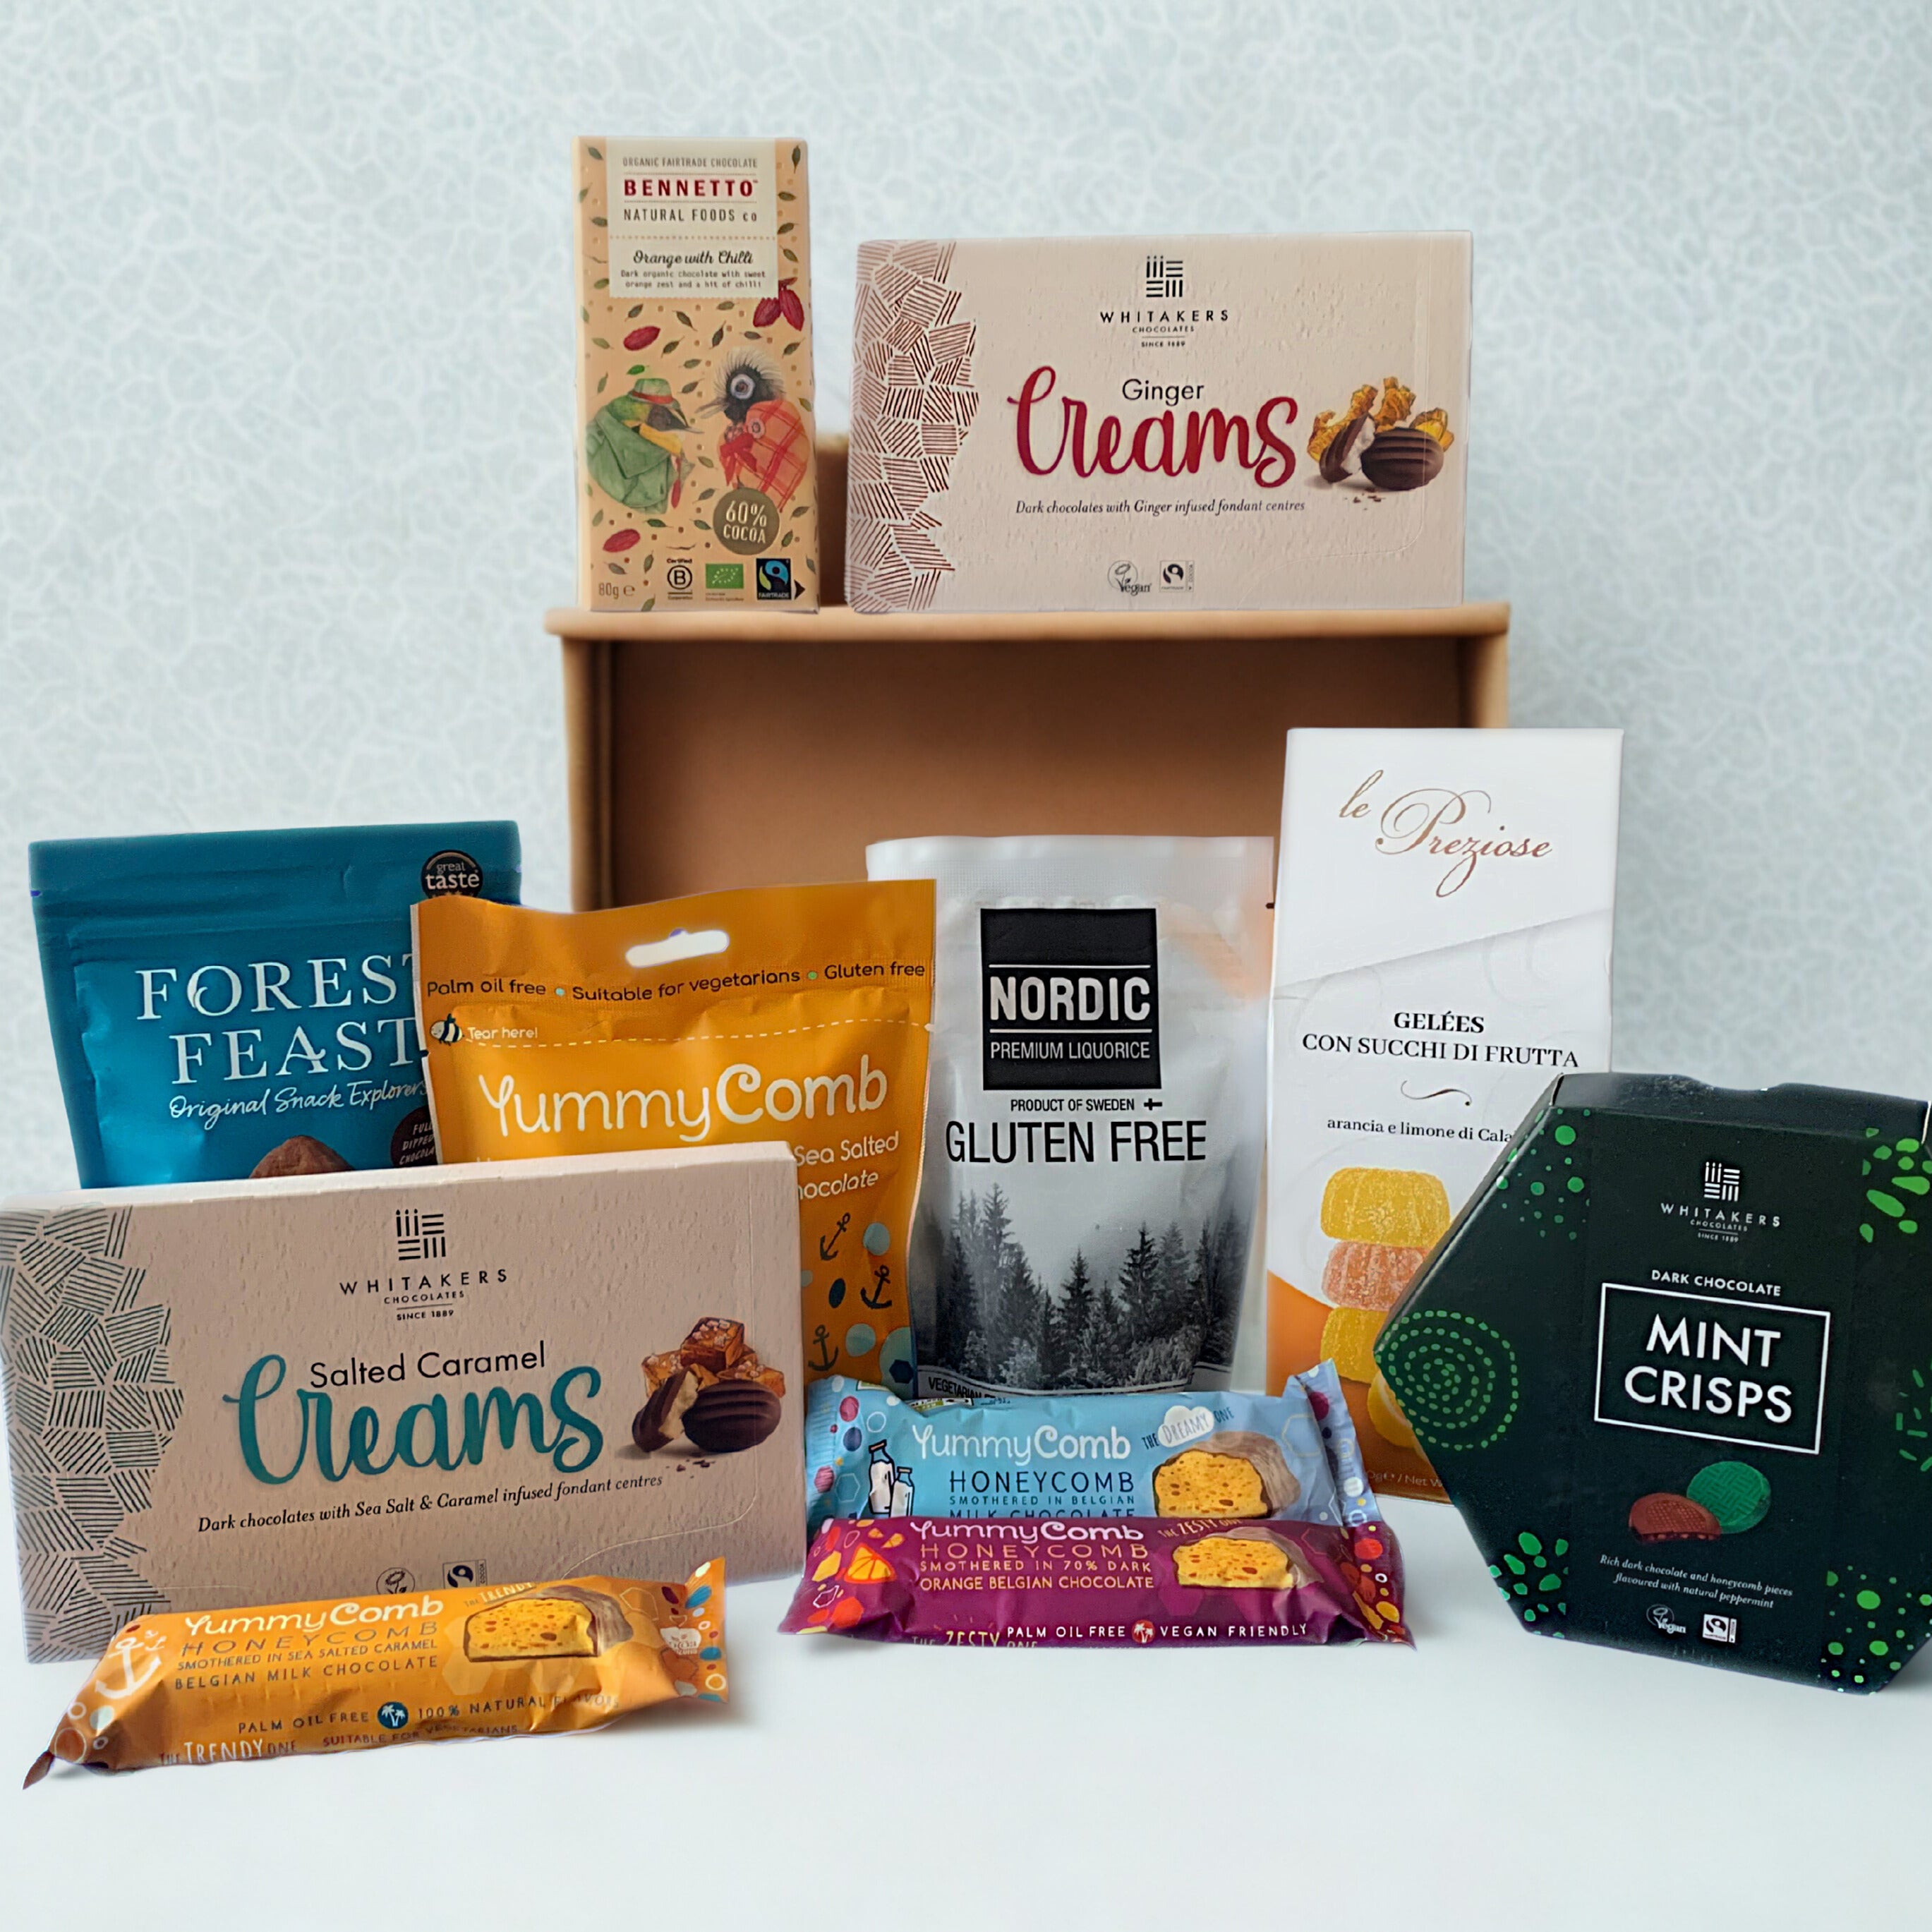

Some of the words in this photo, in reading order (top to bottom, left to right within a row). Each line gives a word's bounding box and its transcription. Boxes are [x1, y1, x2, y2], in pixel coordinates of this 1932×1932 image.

[623, 157, 659, 168] ORGANIC
[662, 157, 707, 168] FAIRTRADE
[711, 157, 758, 169] CHOCOLATE
[624, 209, 684, 222] NATURAL
[692, 209, 735, 222] FOODS
[633, 249, 682, 268] Orange
[684, 250, 713, 264] with
[718, 249, 754, 265] Chilli
[621, 270, 639, 278] Dark
[643, 270, 674, 279] organic
[678, 270, 718, 278] chocolate
[722, 270, 740, 278] with
[1100, 310, 1229, 323] WHITAKERS
[1122, 378, 1204, 406] Ginger
[1007, 366, 1298, 488] Creams
[726, 500, 766, 528] 60%
[1016, 500, 1044, 514] Dark
[1046, 500, 1103, 514] chocolates
[1106, 500, 1130, 513] with
[1134, 500, 1172, 516] Ginger
[1175, 500, 1215, 514] infused
[1216, 500, 1262, 516] fondant
[1266, 500, 1305, 512] centres
[723, 524, 766, 544] COCOA
[1339, 770, 1384, 818] le
[1375, 788, 1552, 898] Preziose
[425, 872, 480, 890] taste
[437, 862, 465, 875] great
[427, 979, 474, 997] Palm
[481, 979, 503, 994] oil
[509, 979, 546, 995] free
[572, 986, 653, 1001] Suitable
[658, 982, 685, 998] for
[689, 969, 800, 992] vegetarians
[824, 964, 884, 980] Gluten
[890, 961, 925, 977] free
[989, 976, 1150, 1021] NORDIC
[468, 1027, 498, 1040] Tear
[502, 1026, 538, 1039] here!
[1394, 1010, 1484, 1033] GELÉES
[169, 1017, 418, 1085] FEAST
[991, 1042, 1063, 1059] PREMIUM
[1068, 1042, 1150, 1060] LIQUORICE
[1303, 1033, 1353, 1053] CON
[1358, 1037, 1446, 1060] SUCCHI
[1453, 1044, 1478, 1061] DI
[1484, 1045, 1578, 1068] FRUTTA
[169, 1089, 270, 1130] Original
[274, 1087, 344, 1113] Snack
[478, 1054, 887, 1142] YummyComb
[1010, 1099, 1064, 1111] PRODUCT
[1068, 1099, 1082, 1111] OF
[1086, 1099, 1135, 1111] SWEDEN
[1327, 1117, 1384, 1135] arancia
[1388, 1125, 1397, 1135] e
[1400, 1121, 1454, 1140] limone
[1458, 1125, 1473, 1141] di
[794, 1145, 834, 1168] Sea
[840, 1130, 899, 1162] Salted
[946, 1121, 1094, 1164] GLUTEN
[1111, 1121, 1207, 1162] FREE
[1660, 1202, 1781, 1227] WHITAKERS
[1690, 1219, 1748, 1232] CHOCOLATES
[1698, 1232, 1719, 1240] SINCE
[339, 1269, 508, 1296] WHITAKERS
[1652, 1269, 1689, 1285] DARK
[1694, 1275, 1781, 1296] CHOCOLATE
[384, 1290, 465, 1304] CHOCOLATES
[397, 1310, 426, 1320] SINCE
[431, 1309, 454, 1318] 1889
[1646, 1313, 1781, 1368] MINT
[310, 1353, 406, 1389] Salted
[416, 1341, 546, 1379] Caramel
[1624, 1365, 1792, 1423] CRISPS
[222, 1354, 604, 1485] Creams
[1142, 1432, 1159, 1450] THE
[1161, 1412, 1209, 1444] DREAMY
[1214, 1406, 1235, 1423] ONE
[912, 1424, 1131, 1467] YummyComb
[950, 1471, 1134, 1493] HONEYCOMB
[198, 1513, 236, 1533] Dark
[240, 1506, 315, 1528] chocolates
[320, 1501, 351, 1521] with
[355, 1501, 382, 1518] Sea
[386, 1495, 415, 1514] Salt
[419, 1495, 433, 1511] &
[436, 1488, 499, 1509] Caramel
[502, 1483, 553, 1507] infused
[555, 1478, 612, 1502] fondant
[615, 1473, 663, 1491] centres
[950, 1496, 1038, 1505] SMOTHERED
[1049, 1496, 1062, 1505] IN
[1072, 1495, 1135, 1505] BELGIAN
[910, 1521, 1144, 1544] YummyComb
[1177, 1519, 1219, 1535] ZESTY
[920, 1543, 1149, 1559] HONEYCOMB
[920, 1560, 1025, 1572] SMOTHERED
[1035, 1559, 1053, 1571] IN
[1063, 1559, 1098, 1571] 70%
[1107, 1560, 1152, 1572] DARK
[1600, 1554, 1620, 1567] Rich
[1622, 1558, 1643, 1571] dark
[1645, 1563, 1689, 1579] chocolate
[1690, 1570, 1708, 1582] and
[1710, 1574, 1763, 1592] honeycomb
[1764, 1583, 1793, 1597] pieces
[920, 1576, 984, 1591] ORANGE
[989, 1576, 1053, 1590] BELGIAN
[1058, 1576, 1154, 1589] CHOCOLATE
[1613, 1572, 1659, 1588] flavoured
[1661, 1580, 1681, 1592] with
[1683, 1585, 1719, 1599] natural
[1720, 1590, 1774, 1608] peppermint
[185, 1594, 445, 1636] YummyComb
[181, 1621, 437, 1657] HONEYCOMB
[1007, 1626, 1046, 1638] PALM
[1056, 1626, 1083, 1638] OIL
[1089, 1626, 1125, 1637] FREE
[1160, 1626, 1217, 1637] VEGAN
[1228, 1623, 1307, 1637] FRIENDLY
[177, 1653, 261, 1671] SMOTHERED
[267, 1653, 282, 1663] IN
[288, 1650, 313, 1661] SEA
[319, 1645, 368, 1659] SALTED
[374, 1638, 437, 1654] CARAMEL
[175, 1671, 255, 1690] BELGIAN
[267, 1666, 311, 1682] MILK
[323, 1655, 438, 1676] CHOCOLATE
[239, 1719, 282, 1734] PALM
[294, 1715, 323, 1728] OIL
[330, 1711, 369, 1723] FREE
[418, 1704, 460, 1719] 100%
[470, 1696, 545, 1714] NATURAL
[184, 1738, 263, 1763] TRENDY
[267, 1740, 296, 1755] ONE
[322, 1733, 385, 1747] SUITABLE
[392, 1731, 420, 1741] FOR
